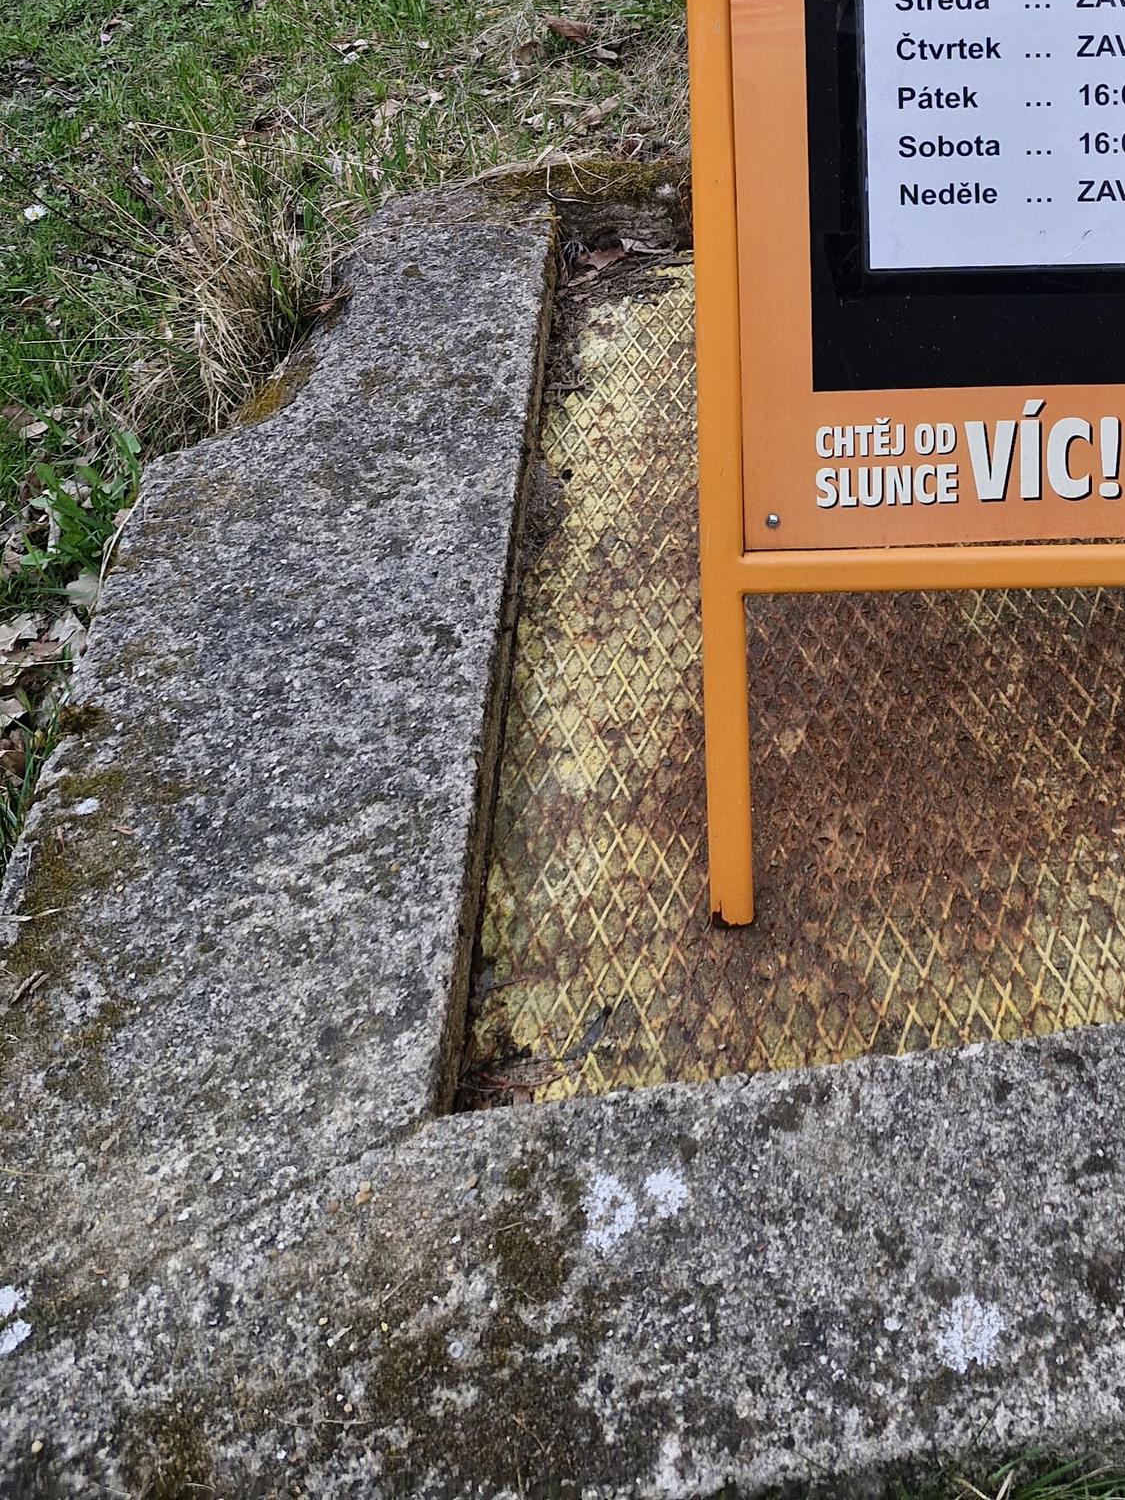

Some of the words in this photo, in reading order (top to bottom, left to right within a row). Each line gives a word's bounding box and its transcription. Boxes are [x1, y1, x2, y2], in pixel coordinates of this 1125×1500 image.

[896, 32, 1002, 60] Čtvrtek
[897, 85, 979, 109] Pátek
[898, 134, 1001, 158] Sobota
[899, 181, 998, 206] Neděle
[815, 417, 906, 458] CHTĚJ
[914, 422, 957, 455] OD
[964, 399, 1122, 503] VÍC!
[815, 464, 959, 509] SLUNCE
